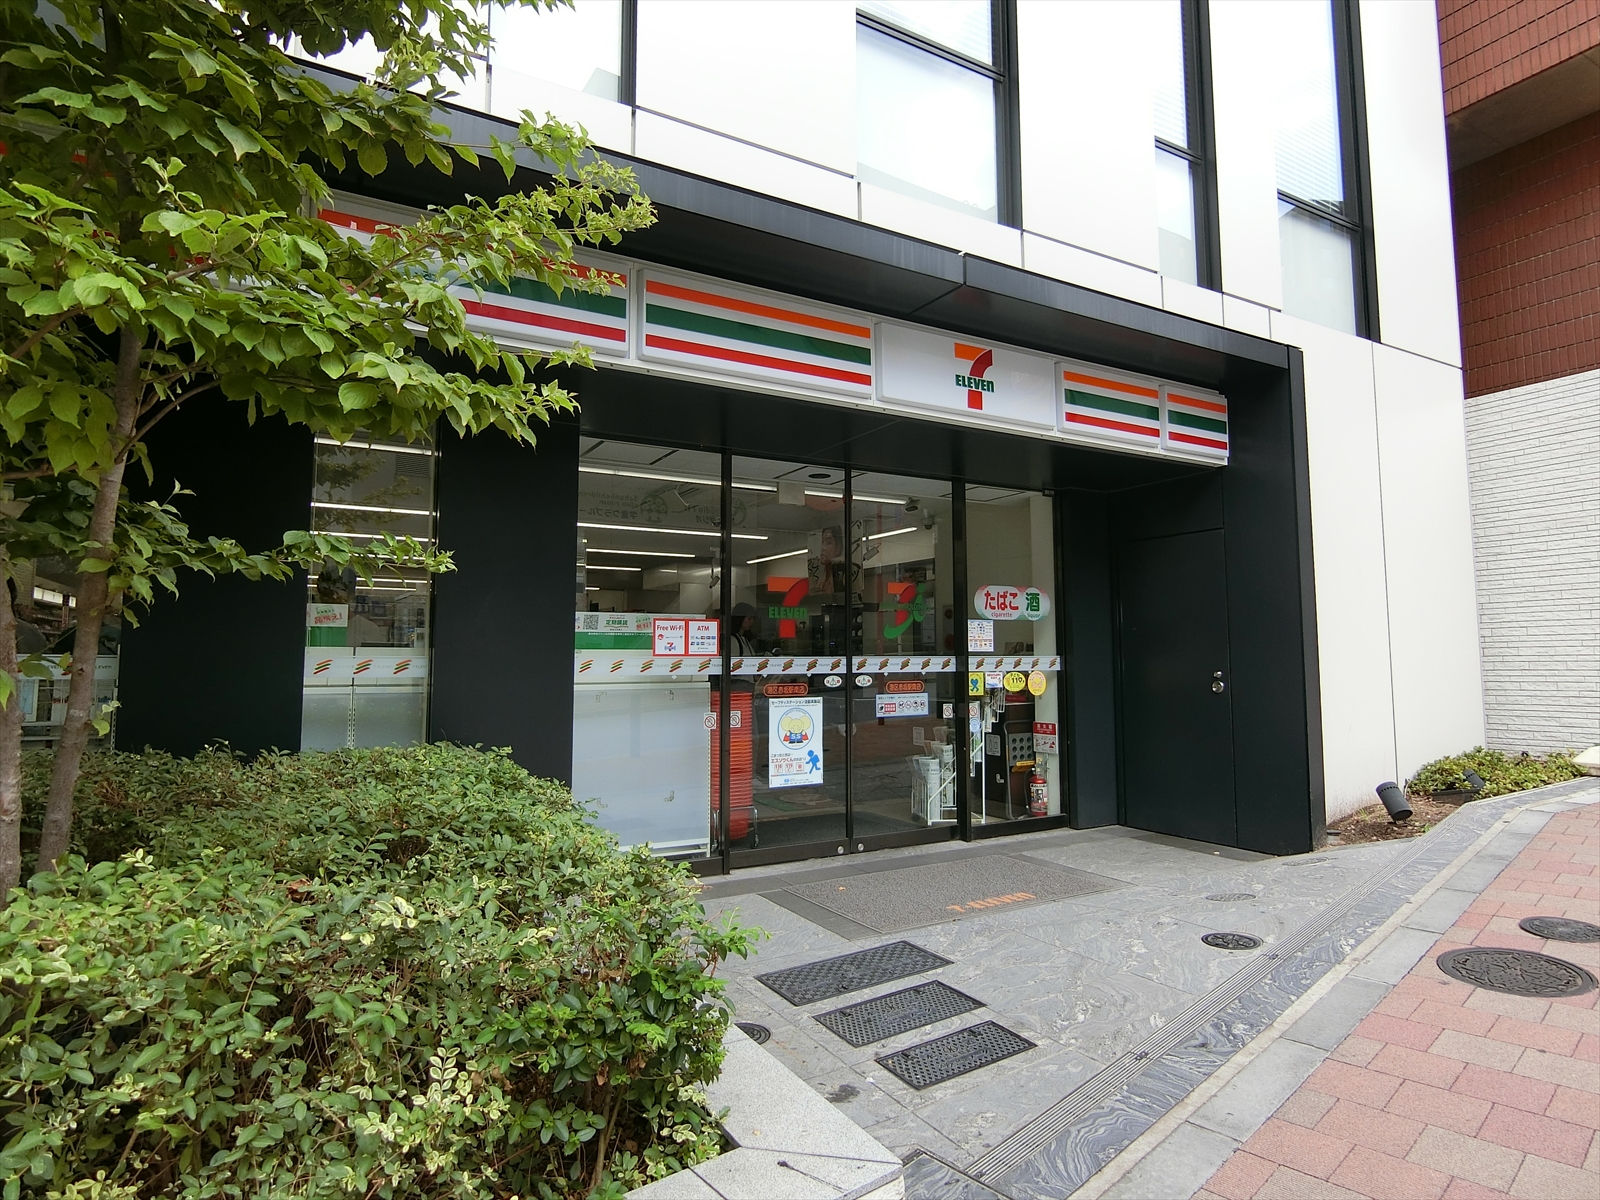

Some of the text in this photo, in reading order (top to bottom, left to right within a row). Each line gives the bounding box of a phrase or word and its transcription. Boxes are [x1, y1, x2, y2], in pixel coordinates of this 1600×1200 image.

[954, 342, 993, 410] 7
[767, 576, 809, 638] 7
[984, 590, 1019, 611] たばこ
[1025, 592, 1040, 612] 酒
